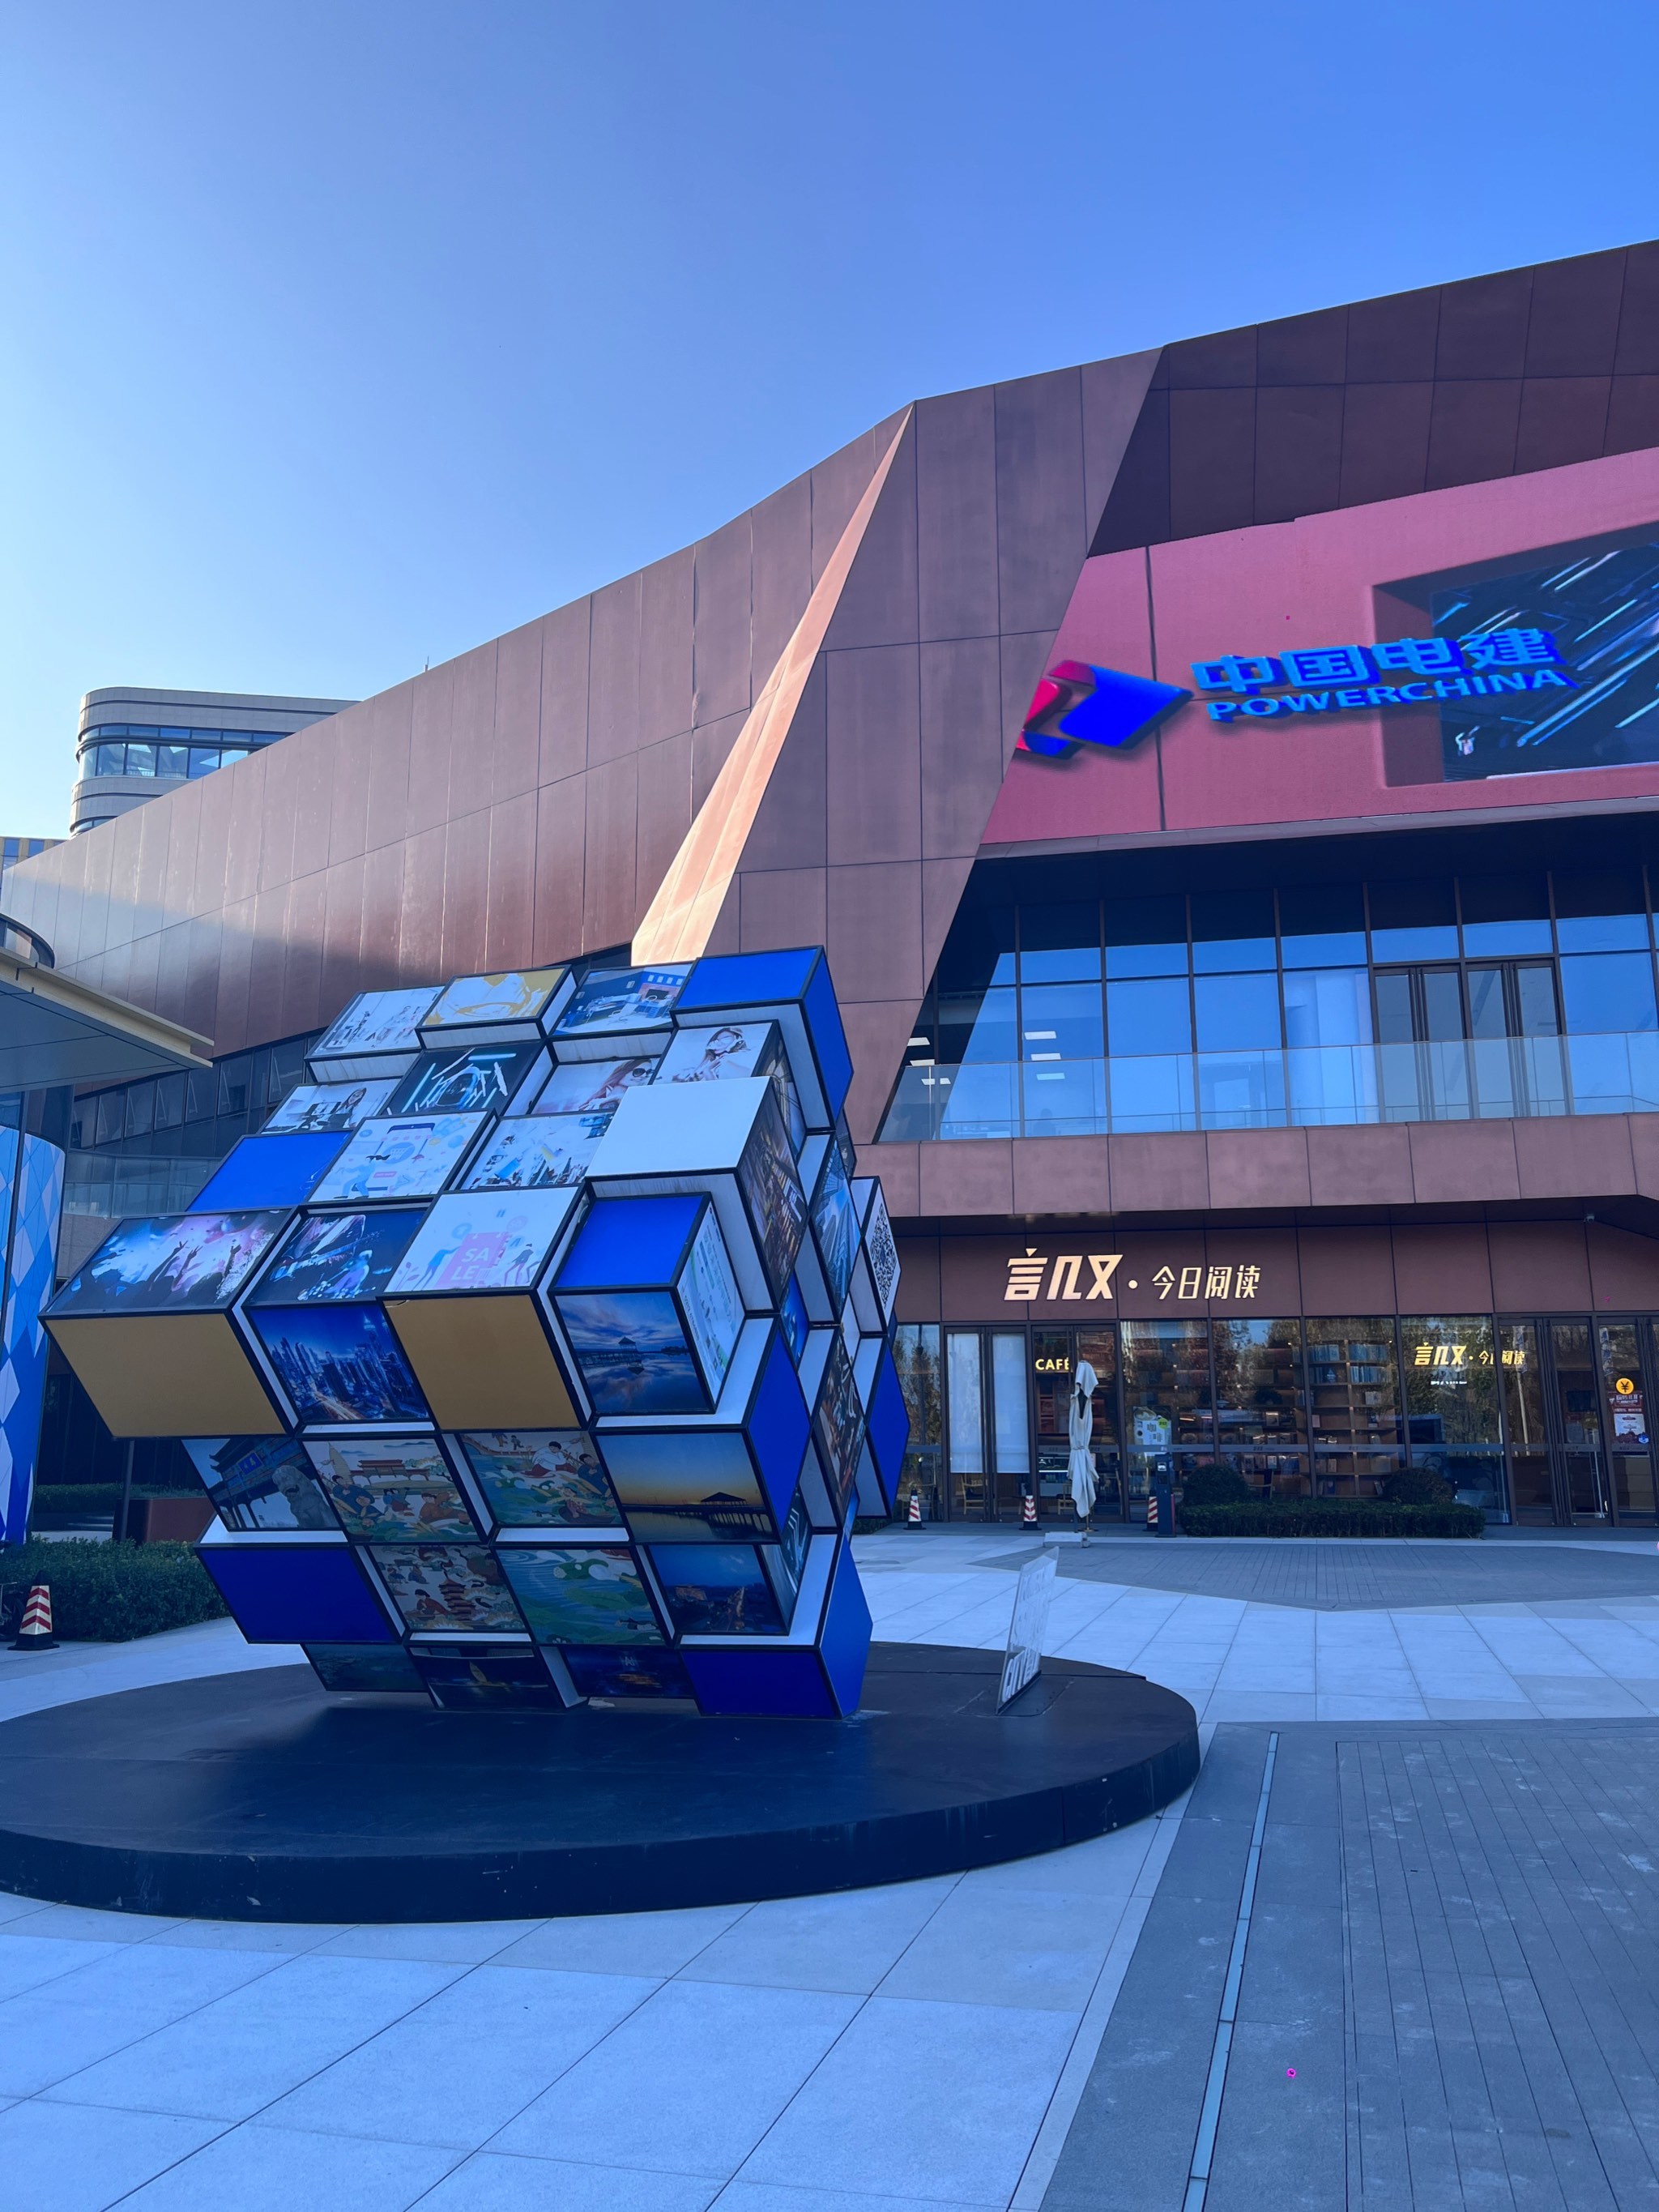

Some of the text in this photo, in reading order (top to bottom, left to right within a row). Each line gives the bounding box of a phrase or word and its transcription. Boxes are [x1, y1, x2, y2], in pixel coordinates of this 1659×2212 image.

[1190, 628, 1563, 694] 中国电建
[1207, 668, 1576, 721] POWERCHINA
